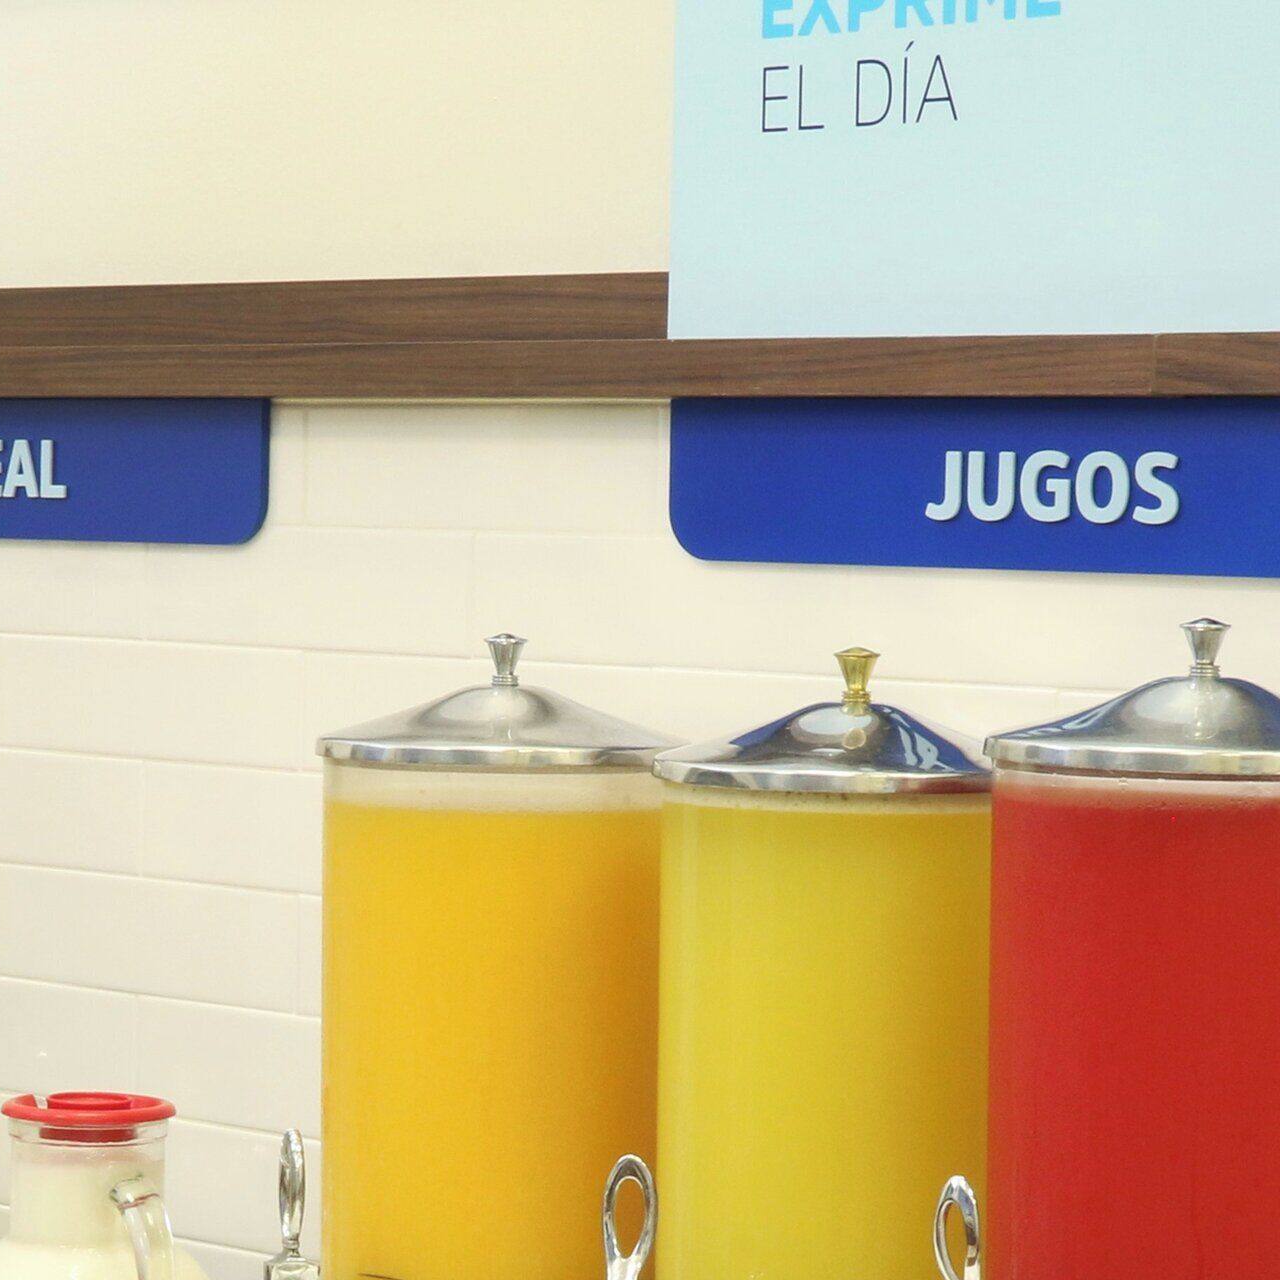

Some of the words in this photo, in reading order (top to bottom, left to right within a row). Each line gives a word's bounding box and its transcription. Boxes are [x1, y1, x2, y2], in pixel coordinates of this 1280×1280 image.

[761, 64, 825, 133] EL
[855, 40, 959, 128] DÍA
[924, 449, 1180, 526] JUGOS
